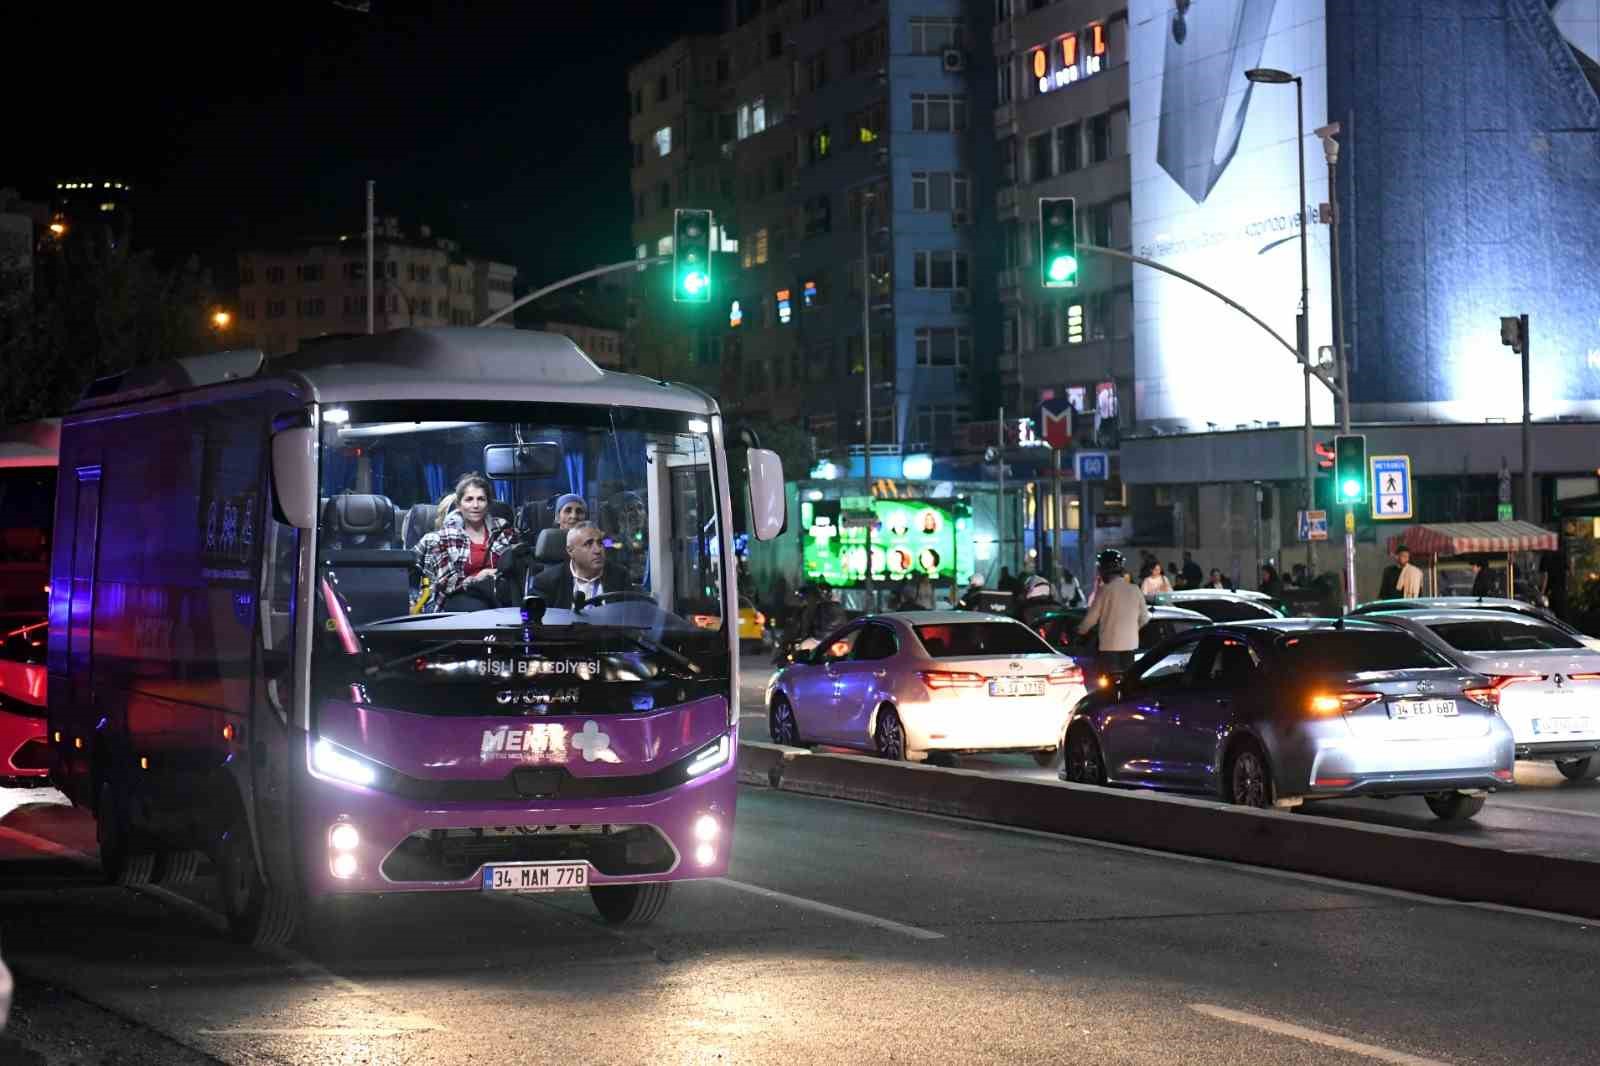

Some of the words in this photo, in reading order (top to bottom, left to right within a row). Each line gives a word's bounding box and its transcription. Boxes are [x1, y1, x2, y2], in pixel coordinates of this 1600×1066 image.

[495, 870, 511, 887] 34
[521, 869, 548, 886] MAM
[556, 867, 584, 885] 778
